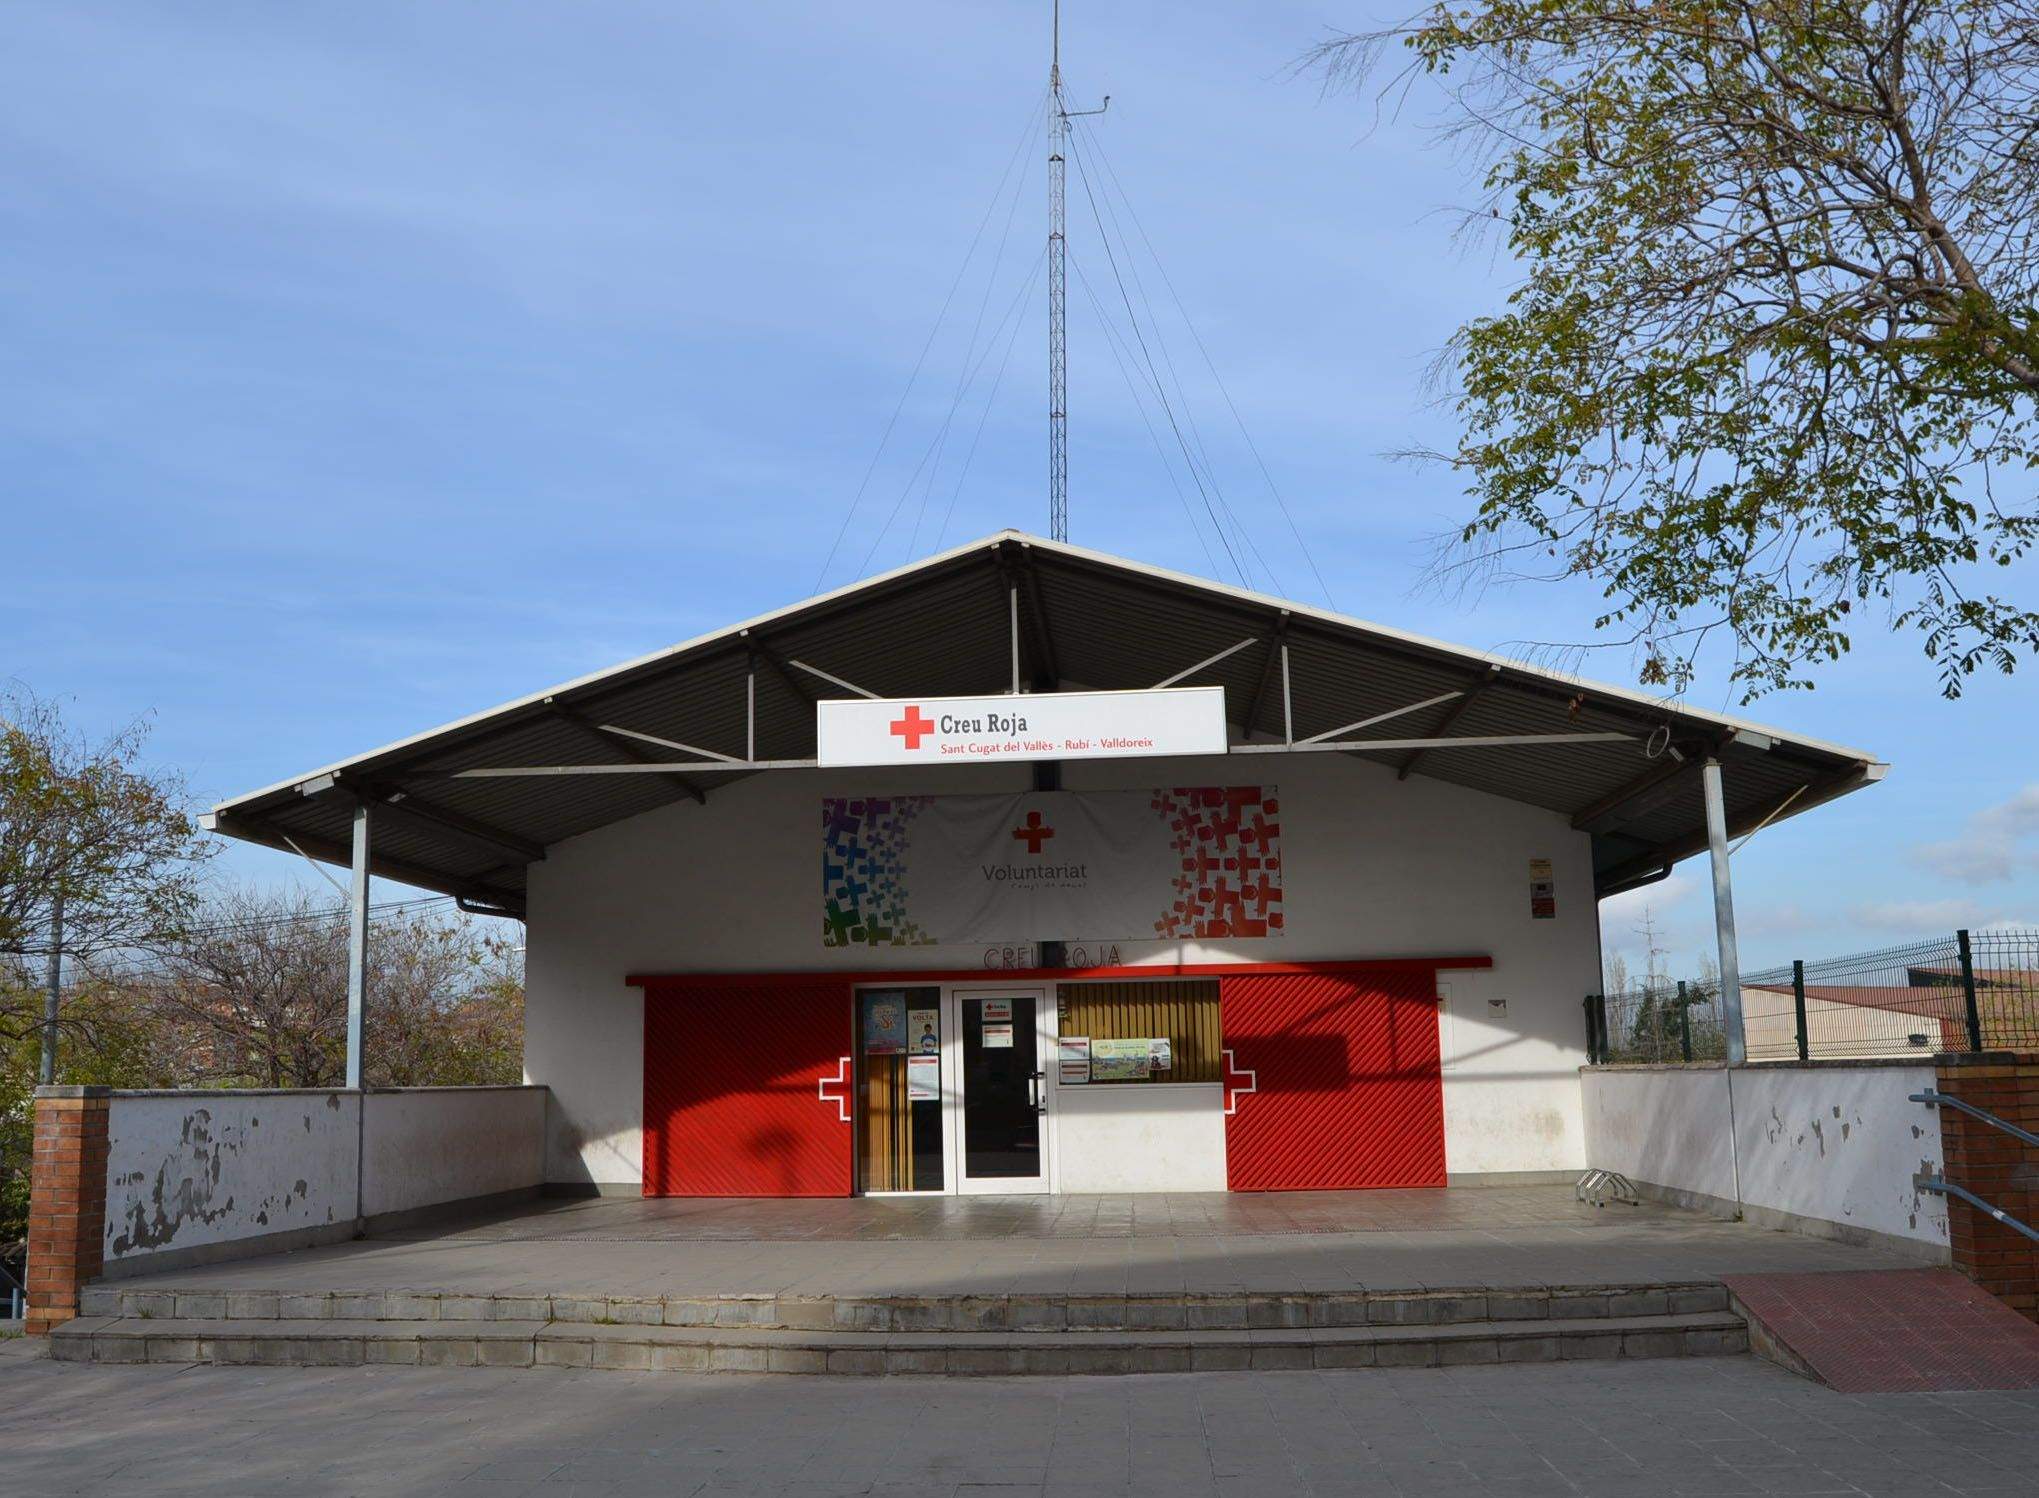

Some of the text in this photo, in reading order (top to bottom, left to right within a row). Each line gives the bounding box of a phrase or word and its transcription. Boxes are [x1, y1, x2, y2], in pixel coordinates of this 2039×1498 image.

[940, 713, 1027, 736] Creu Roja
[941, 743, 965, 754] Sant
[968, 743, 1001, 755] Cugat
[1004, 741, 1020, 752] del
[1023, 739, 1053, 751] Vallès
[1065, 739, 1090, 750] Rubí
[1100, 737, 1153, 749] Valldoreix
[982, 864, 1088, 881] Voluntariat
